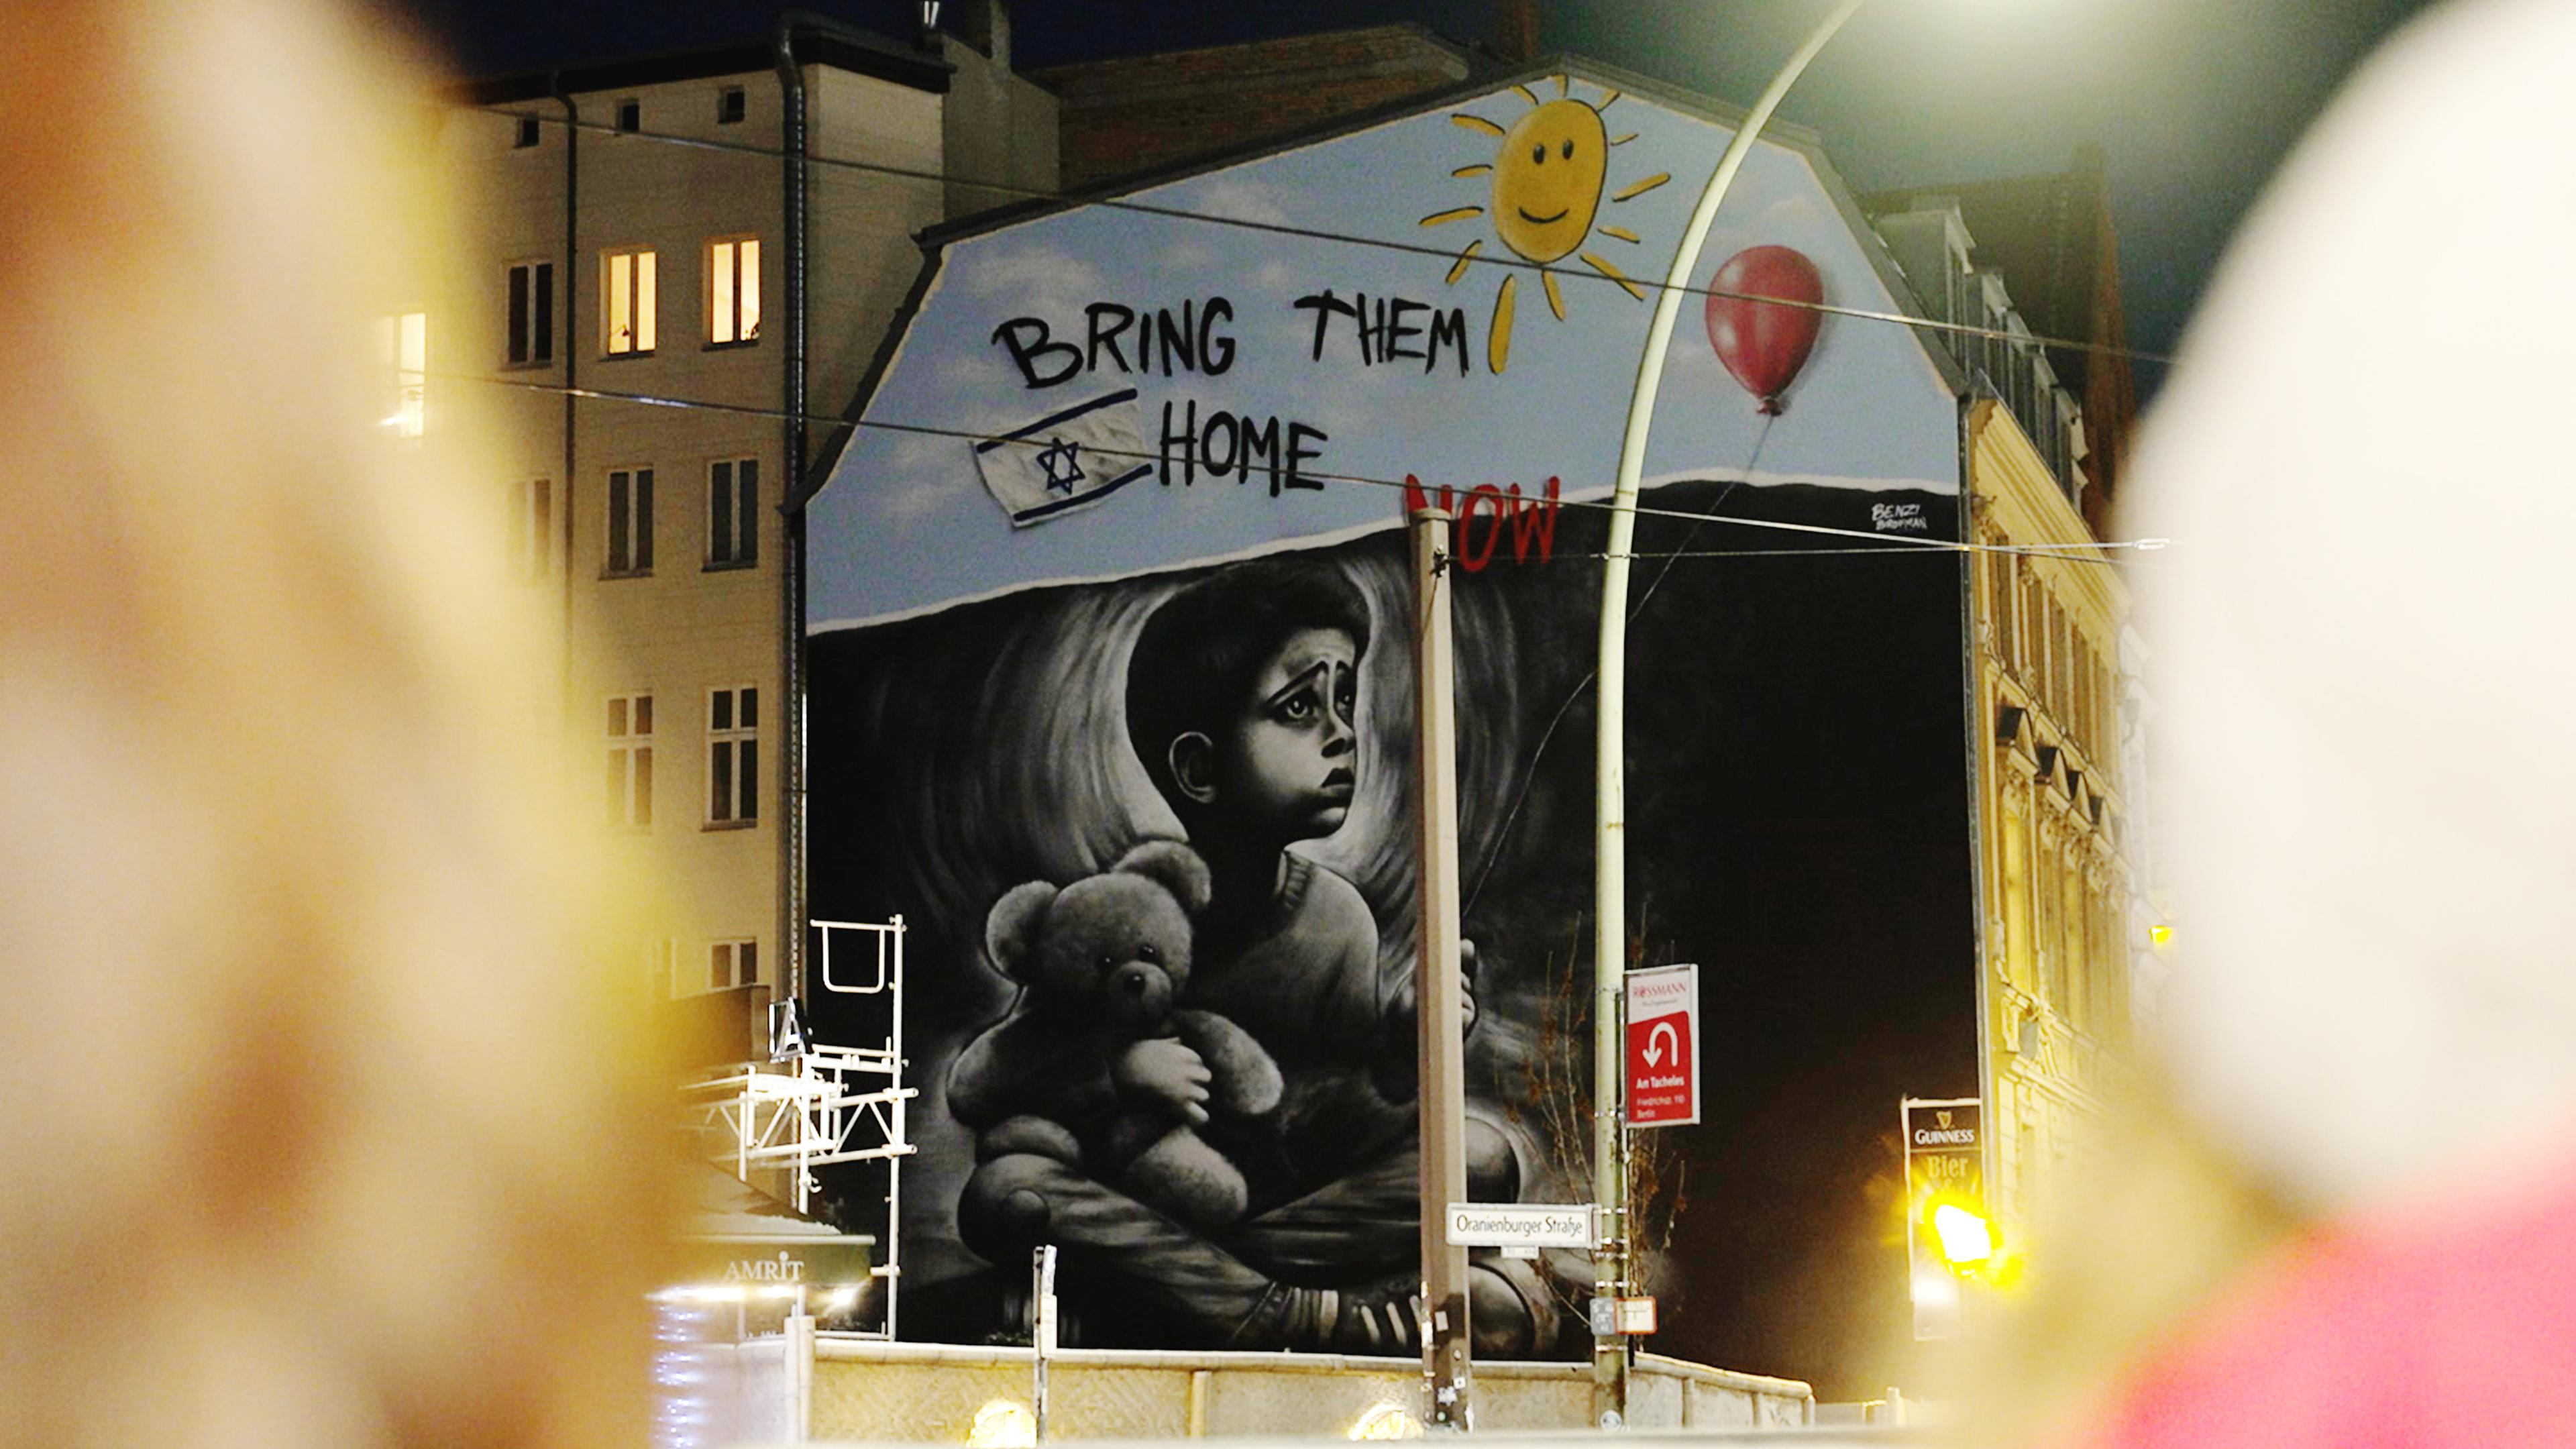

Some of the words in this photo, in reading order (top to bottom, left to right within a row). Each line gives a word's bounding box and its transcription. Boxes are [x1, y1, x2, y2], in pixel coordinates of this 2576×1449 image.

[991, 297, 1236, 389] BRING
[1293, 289, 1470, 378] THEM
[1159, 398, 1328, 498] HOME
[1871, 502, 1921, 521] BENZI
[1915, 1128, 1975, 1144] GUINNESS
[1927, 1155, 1968, 1179] Bier
[1456, 1214, 1542, 1237] Oranienburger
